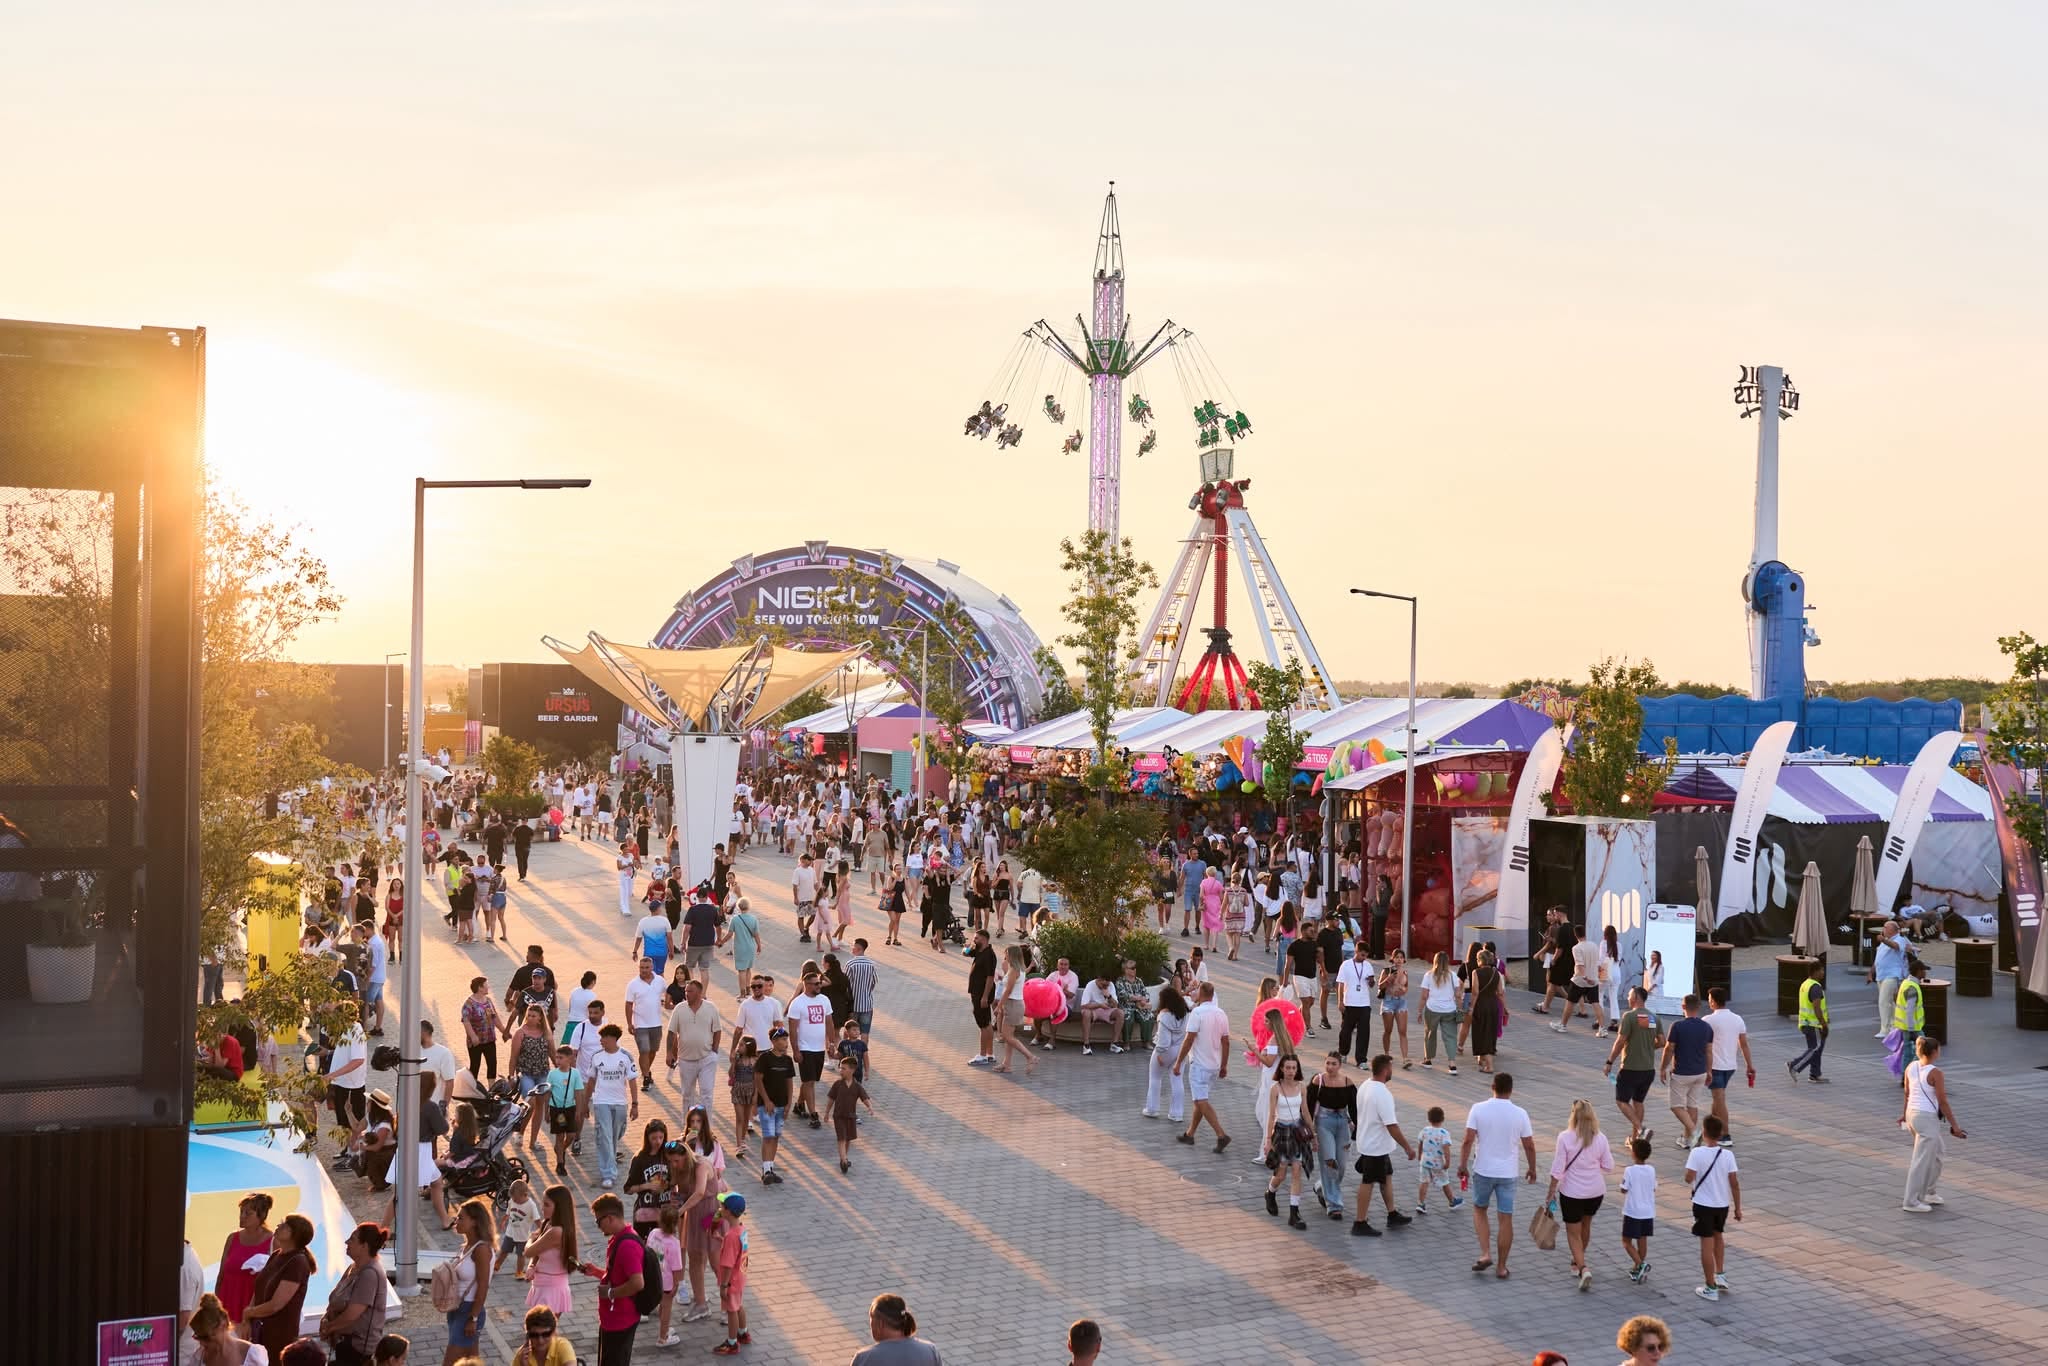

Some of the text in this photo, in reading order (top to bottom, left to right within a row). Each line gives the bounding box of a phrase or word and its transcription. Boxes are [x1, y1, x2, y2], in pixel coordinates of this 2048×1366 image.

[758, 586, 876, 609] NIBIRU
[754, 614, 776, 625] SEE
[779, 614, 803, 625] YOU
[545, 697, 591, 713] URSUS
[537, 714, 598, 722] BEER GARDEN
[1312, 753, 1328, 764] TOSS
[810, 1014, 823, 1022] GO
